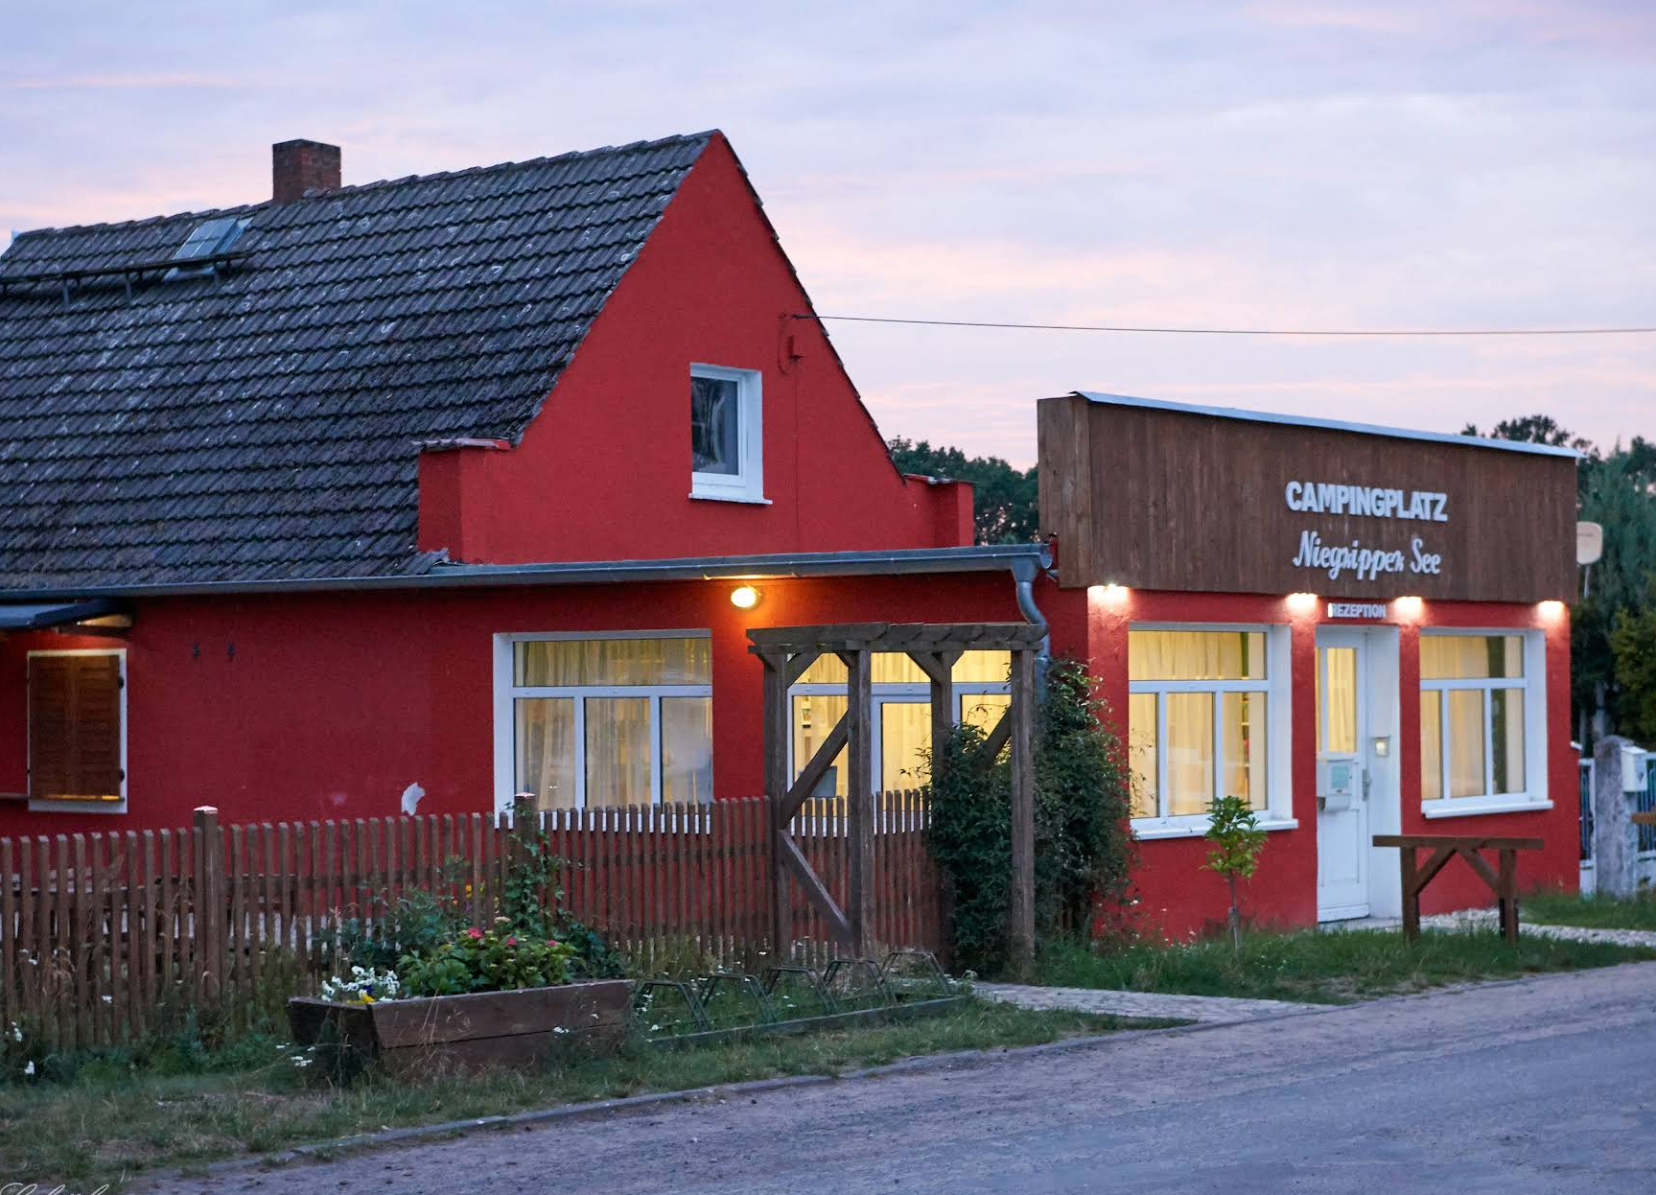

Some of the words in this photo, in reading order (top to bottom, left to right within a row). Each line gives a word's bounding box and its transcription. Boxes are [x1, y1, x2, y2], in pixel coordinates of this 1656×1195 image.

[1285, 480, 1449, 522] CAMPINGPLATZ
[1409, 537, 1441, 575] See
[1327, 603, 1386, 618] REZEPTION
